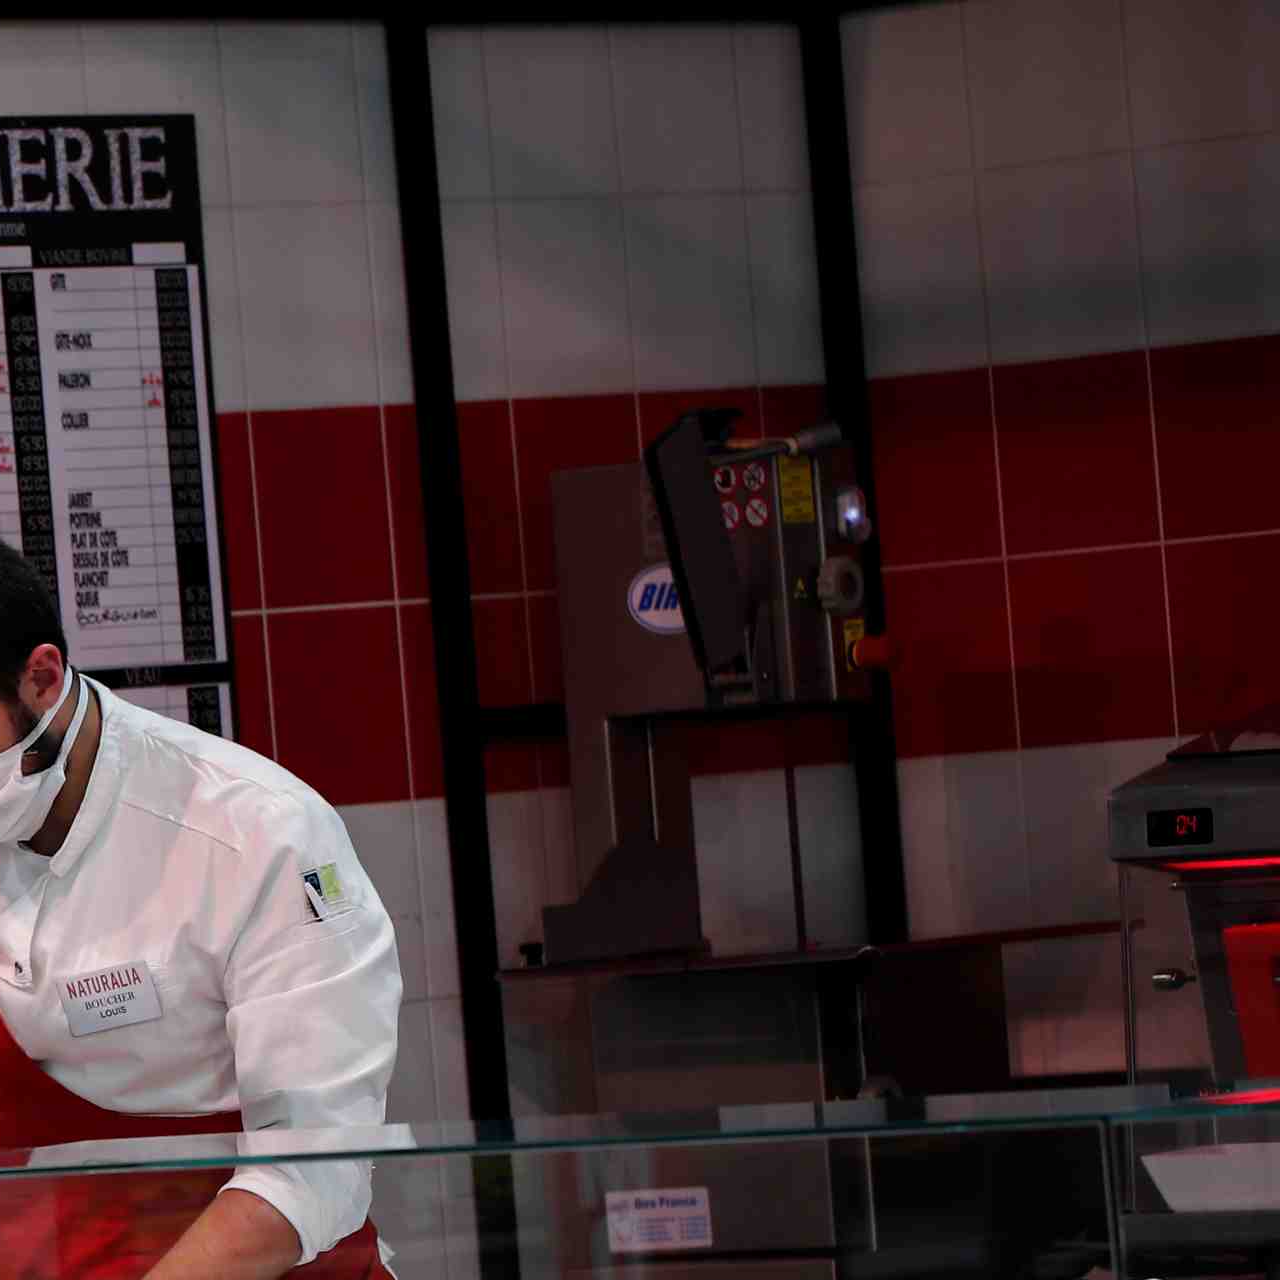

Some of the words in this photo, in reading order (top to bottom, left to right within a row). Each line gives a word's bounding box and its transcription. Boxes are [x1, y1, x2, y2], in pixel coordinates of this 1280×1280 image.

[66, 967, 143, 1000] NATURALIA
[85, 991, 136, 1011] BOUCHER
[100, 1006, 127, 1019] LOUIS
